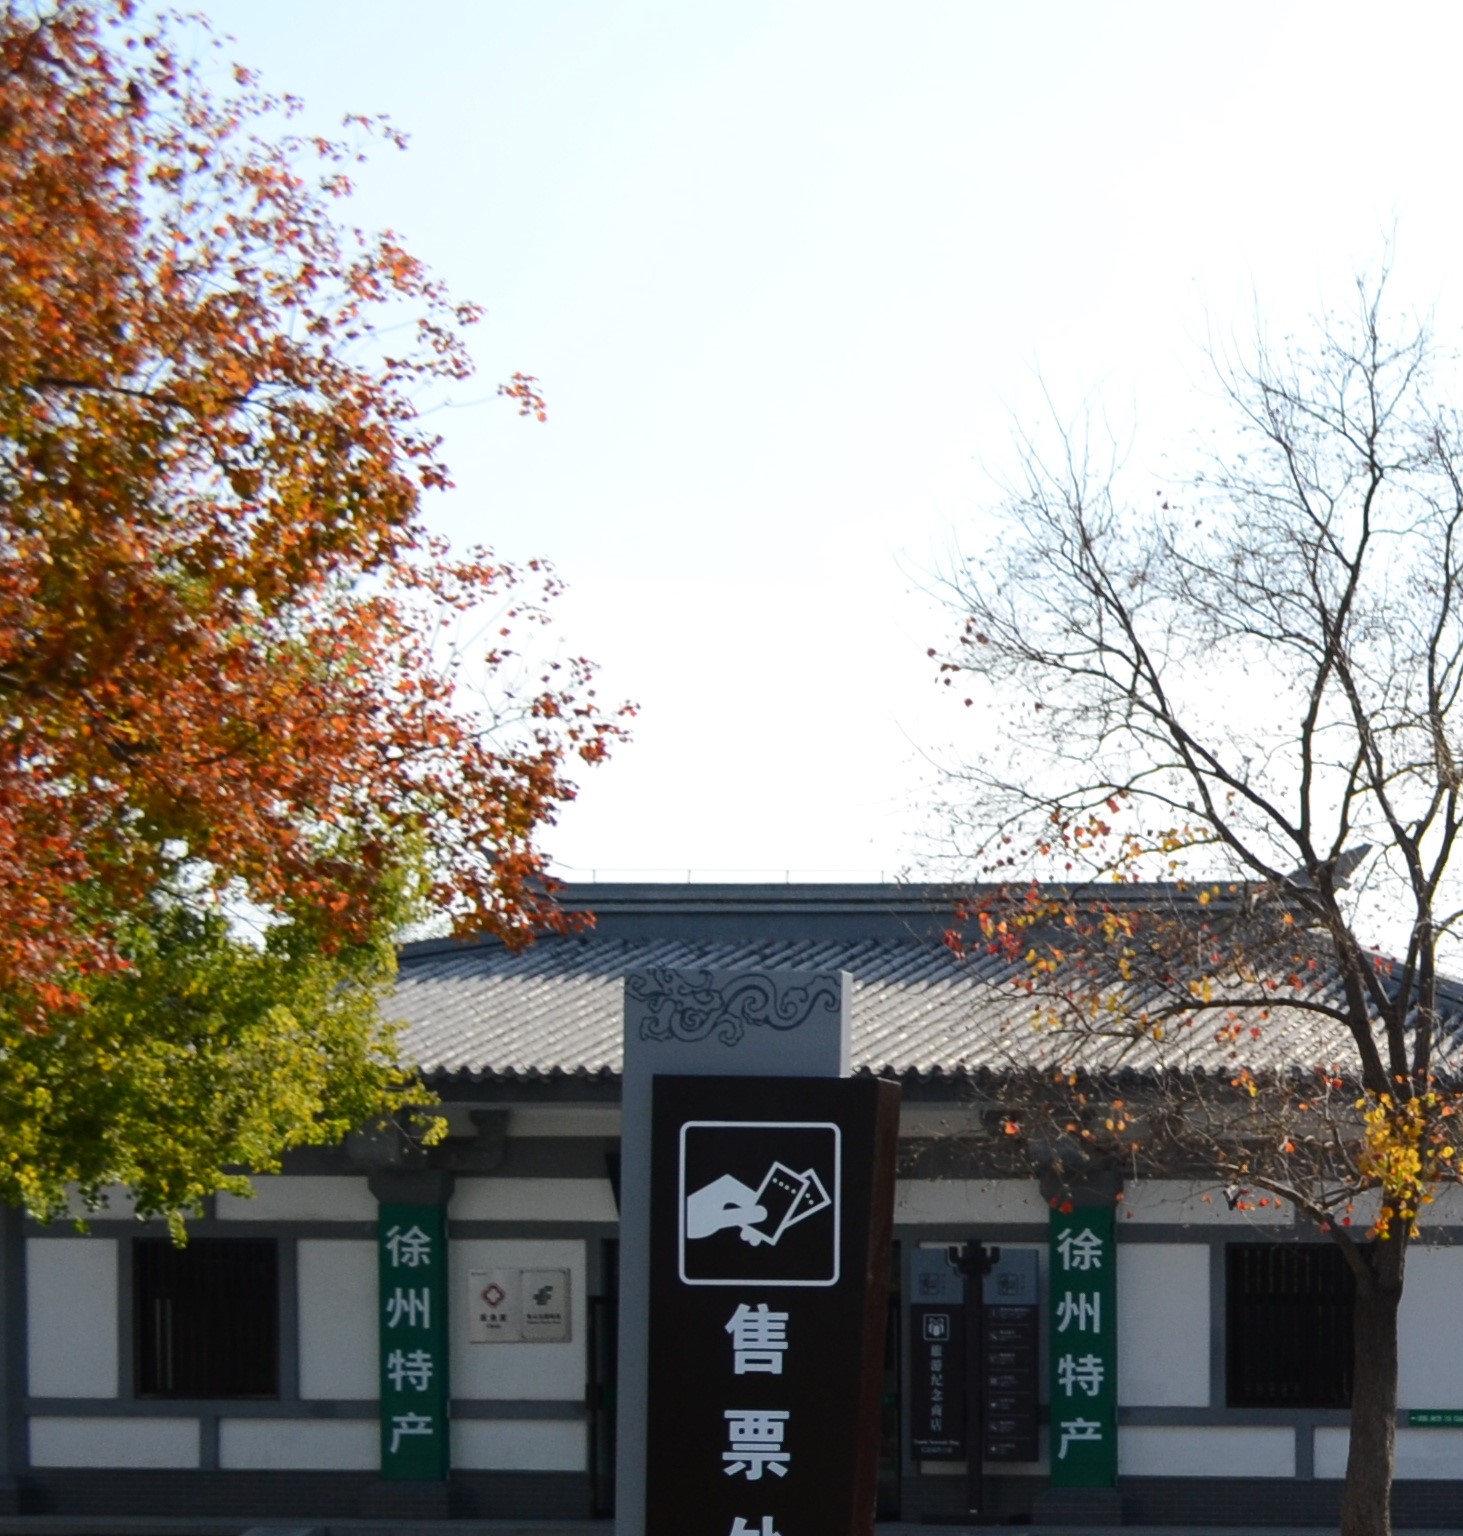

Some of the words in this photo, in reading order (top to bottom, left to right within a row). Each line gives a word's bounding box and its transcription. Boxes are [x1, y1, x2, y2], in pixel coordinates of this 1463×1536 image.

[386, 1225, 433, 1453] 徐州特产
[1056, 1228, 1105, 1459] 徐州特产
